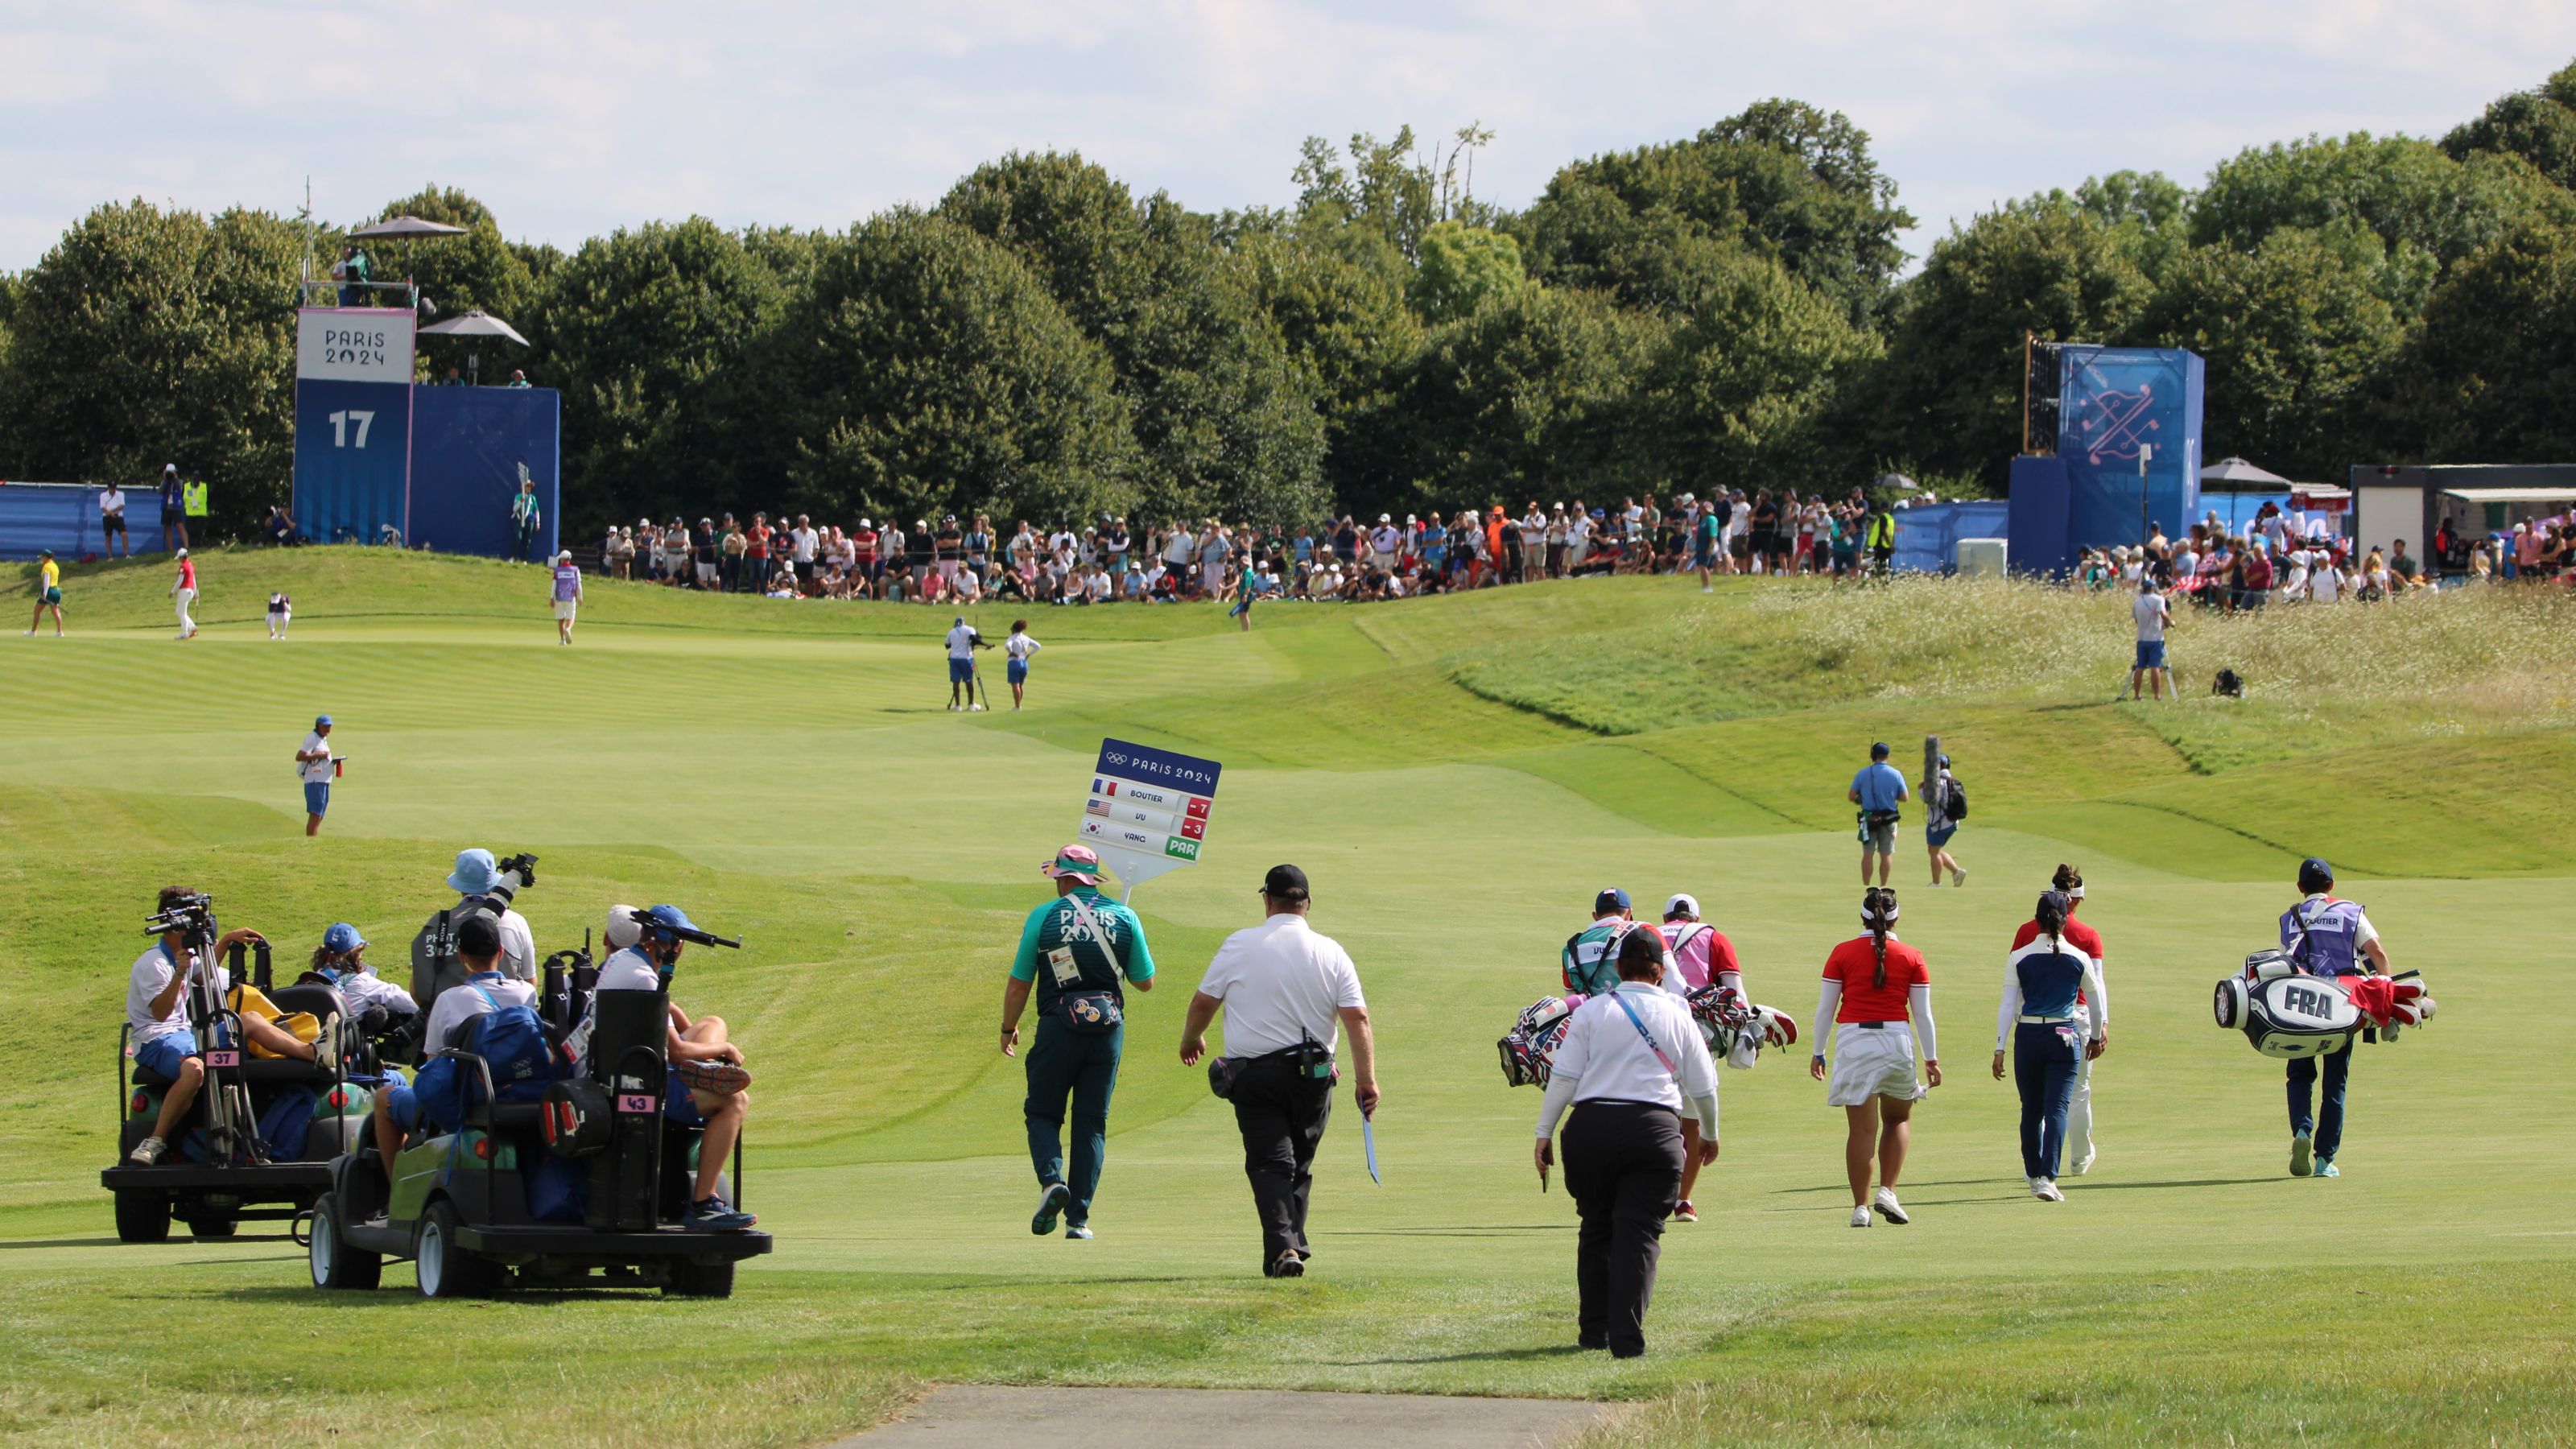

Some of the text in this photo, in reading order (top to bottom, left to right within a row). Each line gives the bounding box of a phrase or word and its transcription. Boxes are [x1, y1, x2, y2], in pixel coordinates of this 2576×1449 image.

[325, 329, 385, 348] PARIS
[325, 348, 385, 365] 2024
[329, 409, 376, 449] 17
[1132, 758, 1212, 784] PARIS 2024
[1130, 790, 1163, 803] BOUTIER
[1135, 812, 1146, 821] VU
[1124, 832, 1195, 856] YANG PAR
[425, 943, 459, 957] 32
[1594, 946, 1605, 955] VU
[2285, 985, 2333, 1021] FRA
[214, 1053, 231, 1064] 37
[627, 1096, 646, 1110] 43
